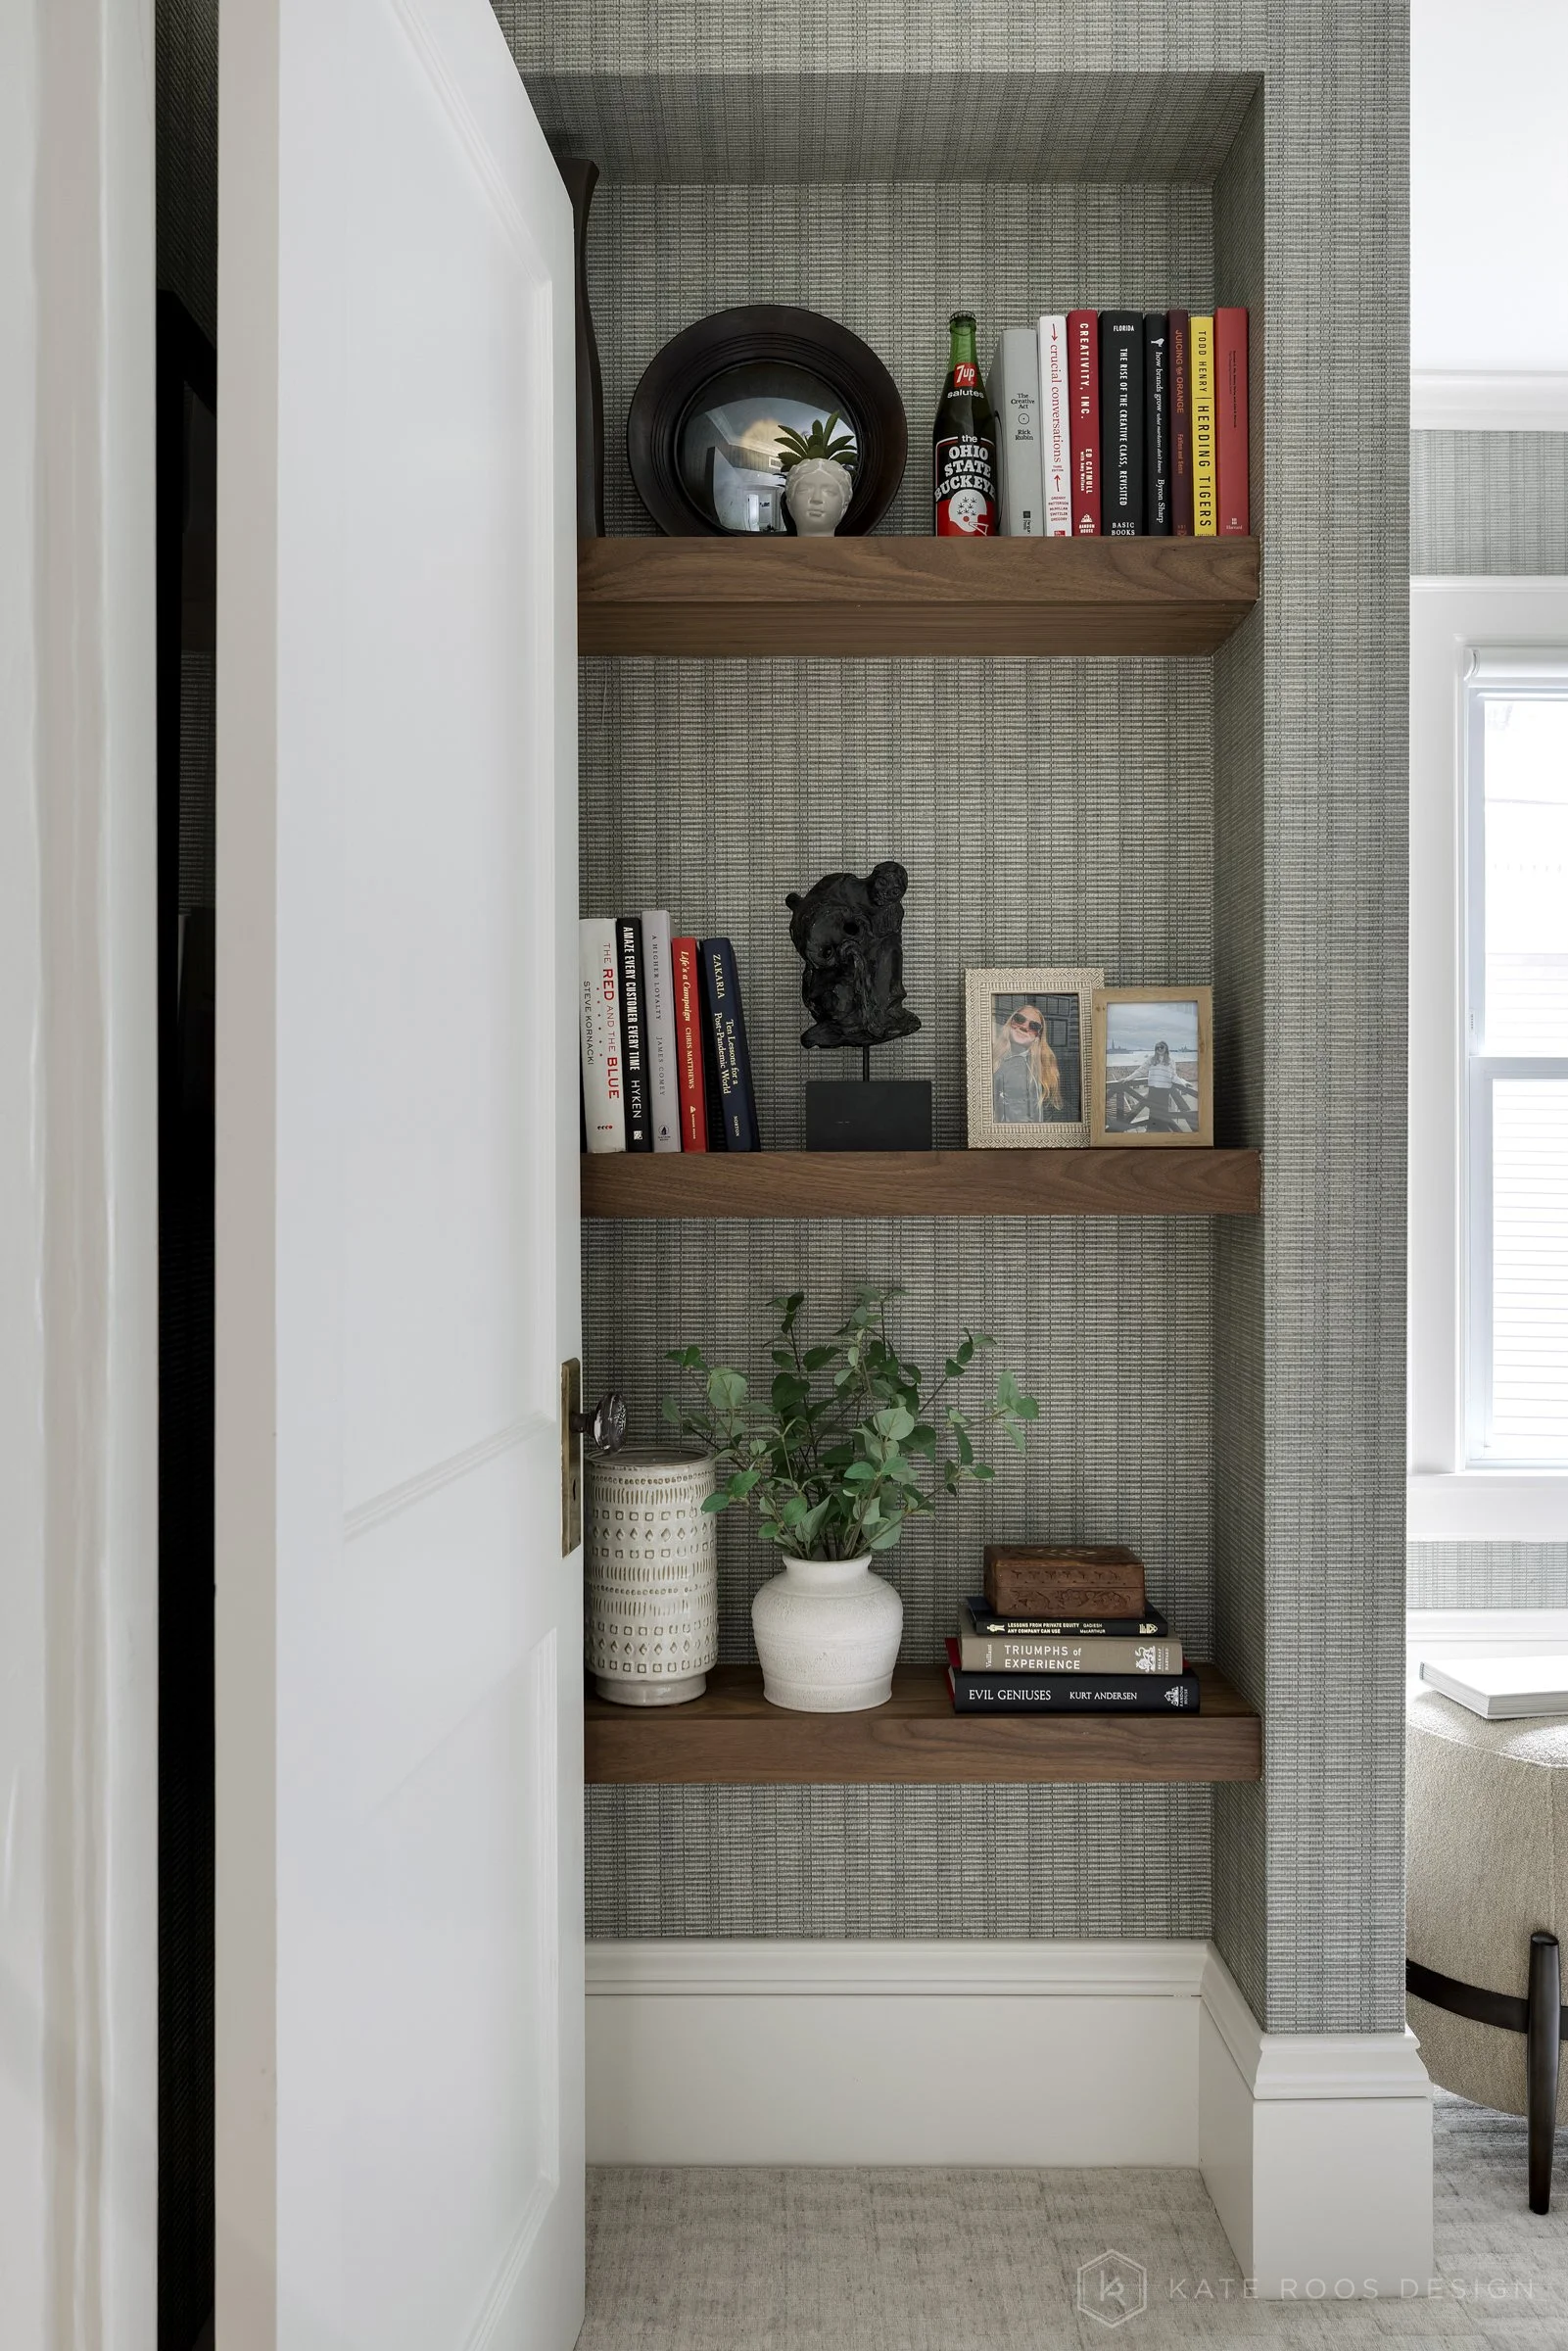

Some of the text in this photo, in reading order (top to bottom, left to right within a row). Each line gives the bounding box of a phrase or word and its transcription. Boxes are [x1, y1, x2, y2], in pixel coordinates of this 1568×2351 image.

[1079, 323, 1089, 419] CREATIVITY, INC.
[1198, 331, 1208, 392] TODD HENRY
[947, 389, 984, 399] salutes
[1119, 382, 1127, 392] OF
[1050, 344, 1064, 463] crucial conversations
[1197, 406, 1211, 466] HERDING
[948, 445, 988, 460] OHIO
[1085, 448, 1092, 457] ED
[1117, 445, 1127, 467] CLASS,
[944, 459, 991, 478] STATE
[1156, 479, 1165, 524] Byron Sharp
[1199, 476, 1212, 526] TIGERS
[680, 951, 689, 973] Life's
[713, 954, 725, 999] ZAKARIA
[602, 968, 614, 1001] RED
[623, 927, 640, 1071] AMAZE EVERY CUSTOMER EVERY TIME
[606, 1005, 615, 1029] AND
[682, 982, 691, 1021] Campaign
[714, 1012, 731, 1094] Post-Pandemic World
[728, 1035, 736, 1066] Lessons
[607, 1057, 619, 1099] BLUE
[731, 1067, 739, 1078] for
[631, 1080, 641, 1118] HYKEN
[1004, 1645, 1069, 1655] TRIUMPHS
[1005, 1659, 1080, 1669] EXPERIENCE
[969, 1689, 1052, 1701] EVIL GENIUSES
[1069, 1691, 1137, 1701] KURT ANDERSEN
